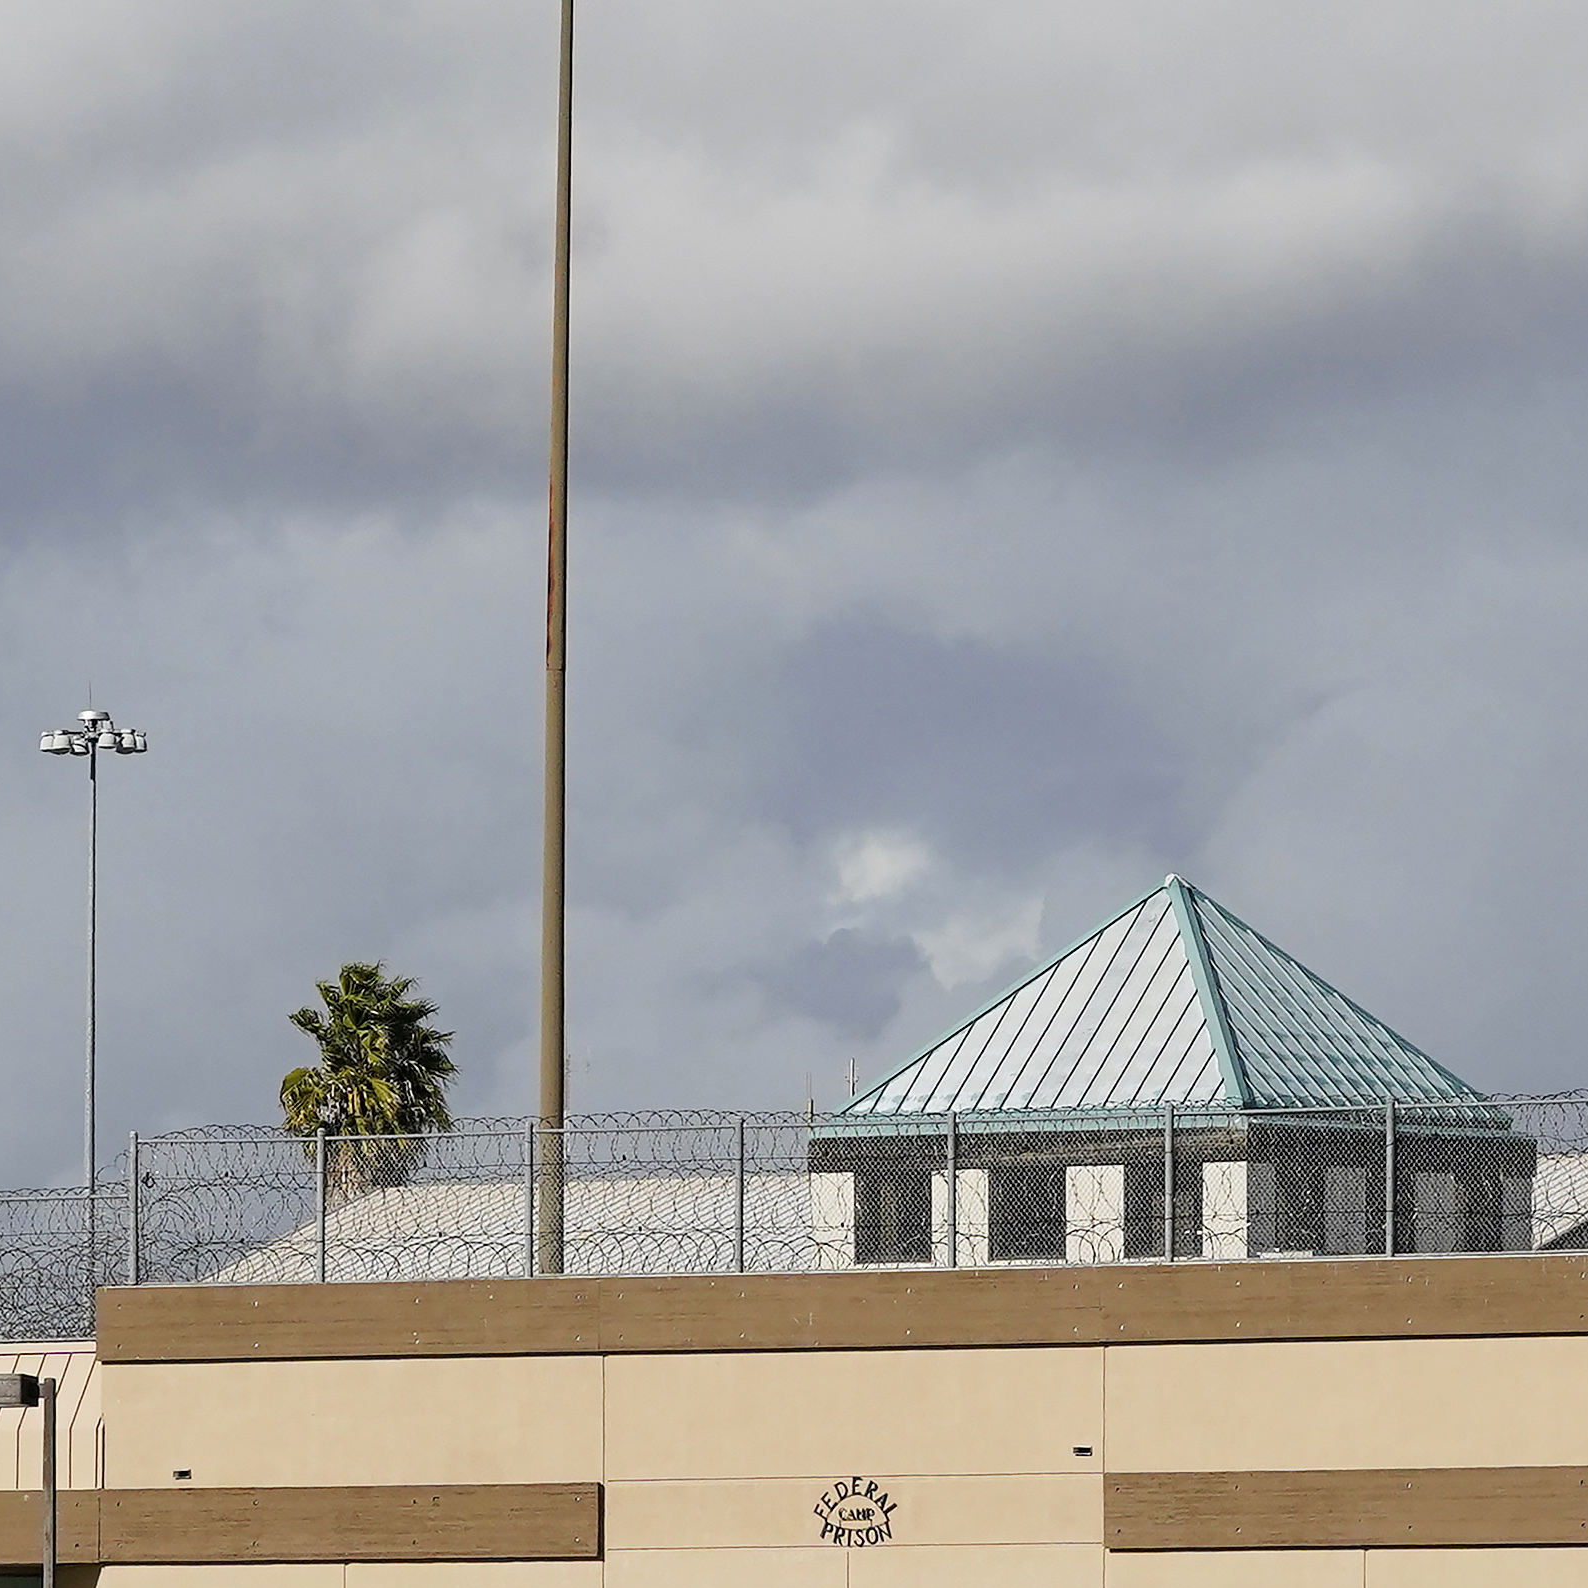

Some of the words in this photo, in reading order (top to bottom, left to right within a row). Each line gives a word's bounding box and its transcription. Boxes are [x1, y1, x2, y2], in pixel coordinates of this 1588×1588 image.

[813, 1476, 898, 1522] FEDERAL
[838, 1508, 876, 1521] CAMP
[820, 1520, 893, 1548] PRISON
